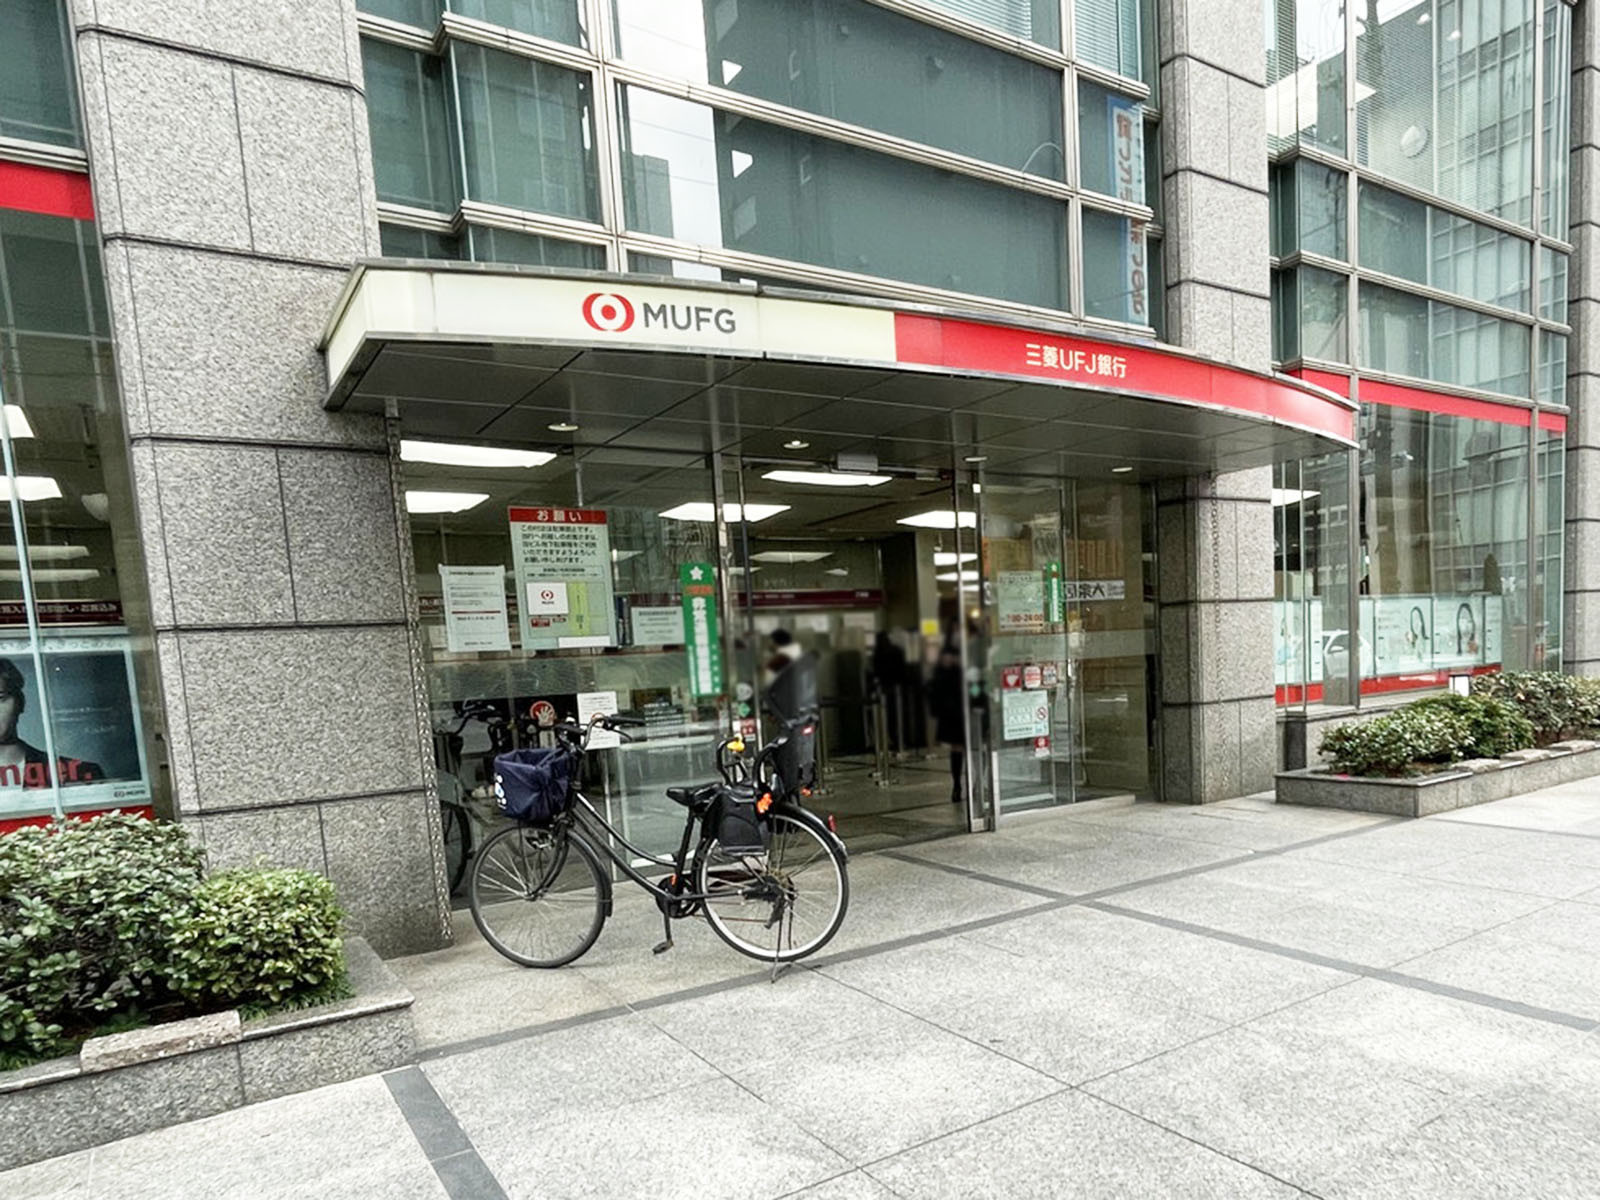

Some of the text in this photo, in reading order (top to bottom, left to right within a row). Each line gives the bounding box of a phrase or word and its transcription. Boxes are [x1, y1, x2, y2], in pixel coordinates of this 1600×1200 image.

[642, 302, 736, 334] MUFG
[1025, 343, 1127, 378] 三菱UFJ銀行
[537, 510, 582, 521] お願い
